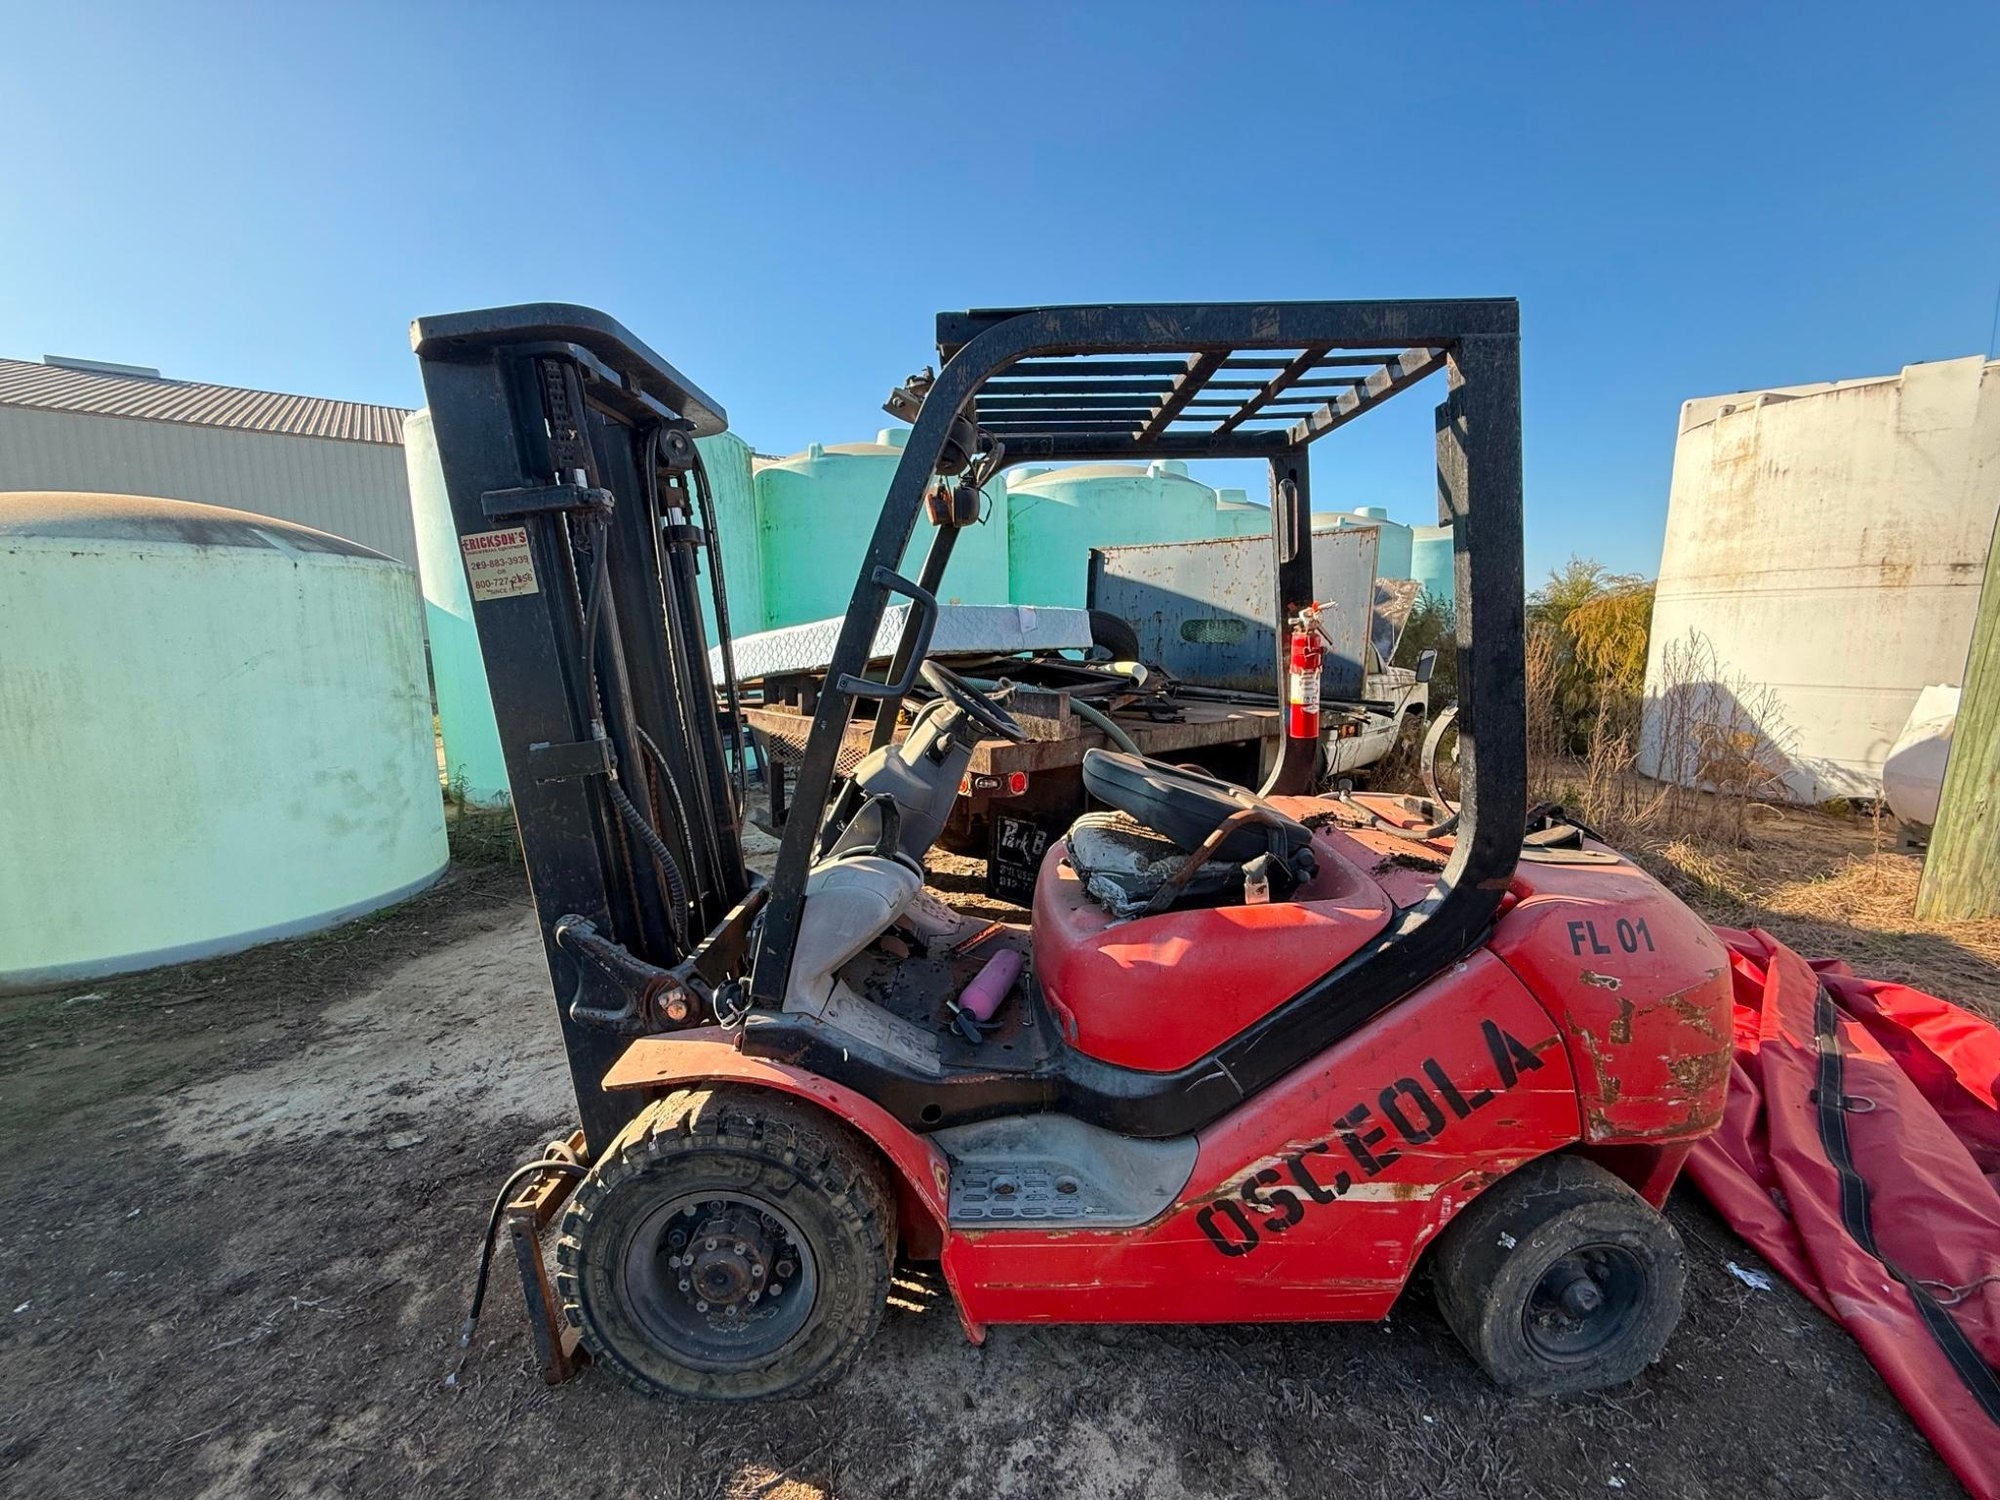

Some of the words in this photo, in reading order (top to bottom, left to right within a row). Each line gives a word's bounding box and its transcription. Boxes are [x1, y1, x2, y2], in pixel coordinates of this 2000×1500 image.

[463, 531, 526, 551] ERICKSON'S
[1567, 920, 1611, 956] FL
[1616, 917, 1655, 953] 01
[1196, 1019, 1545, 1257] OSCEOLA
